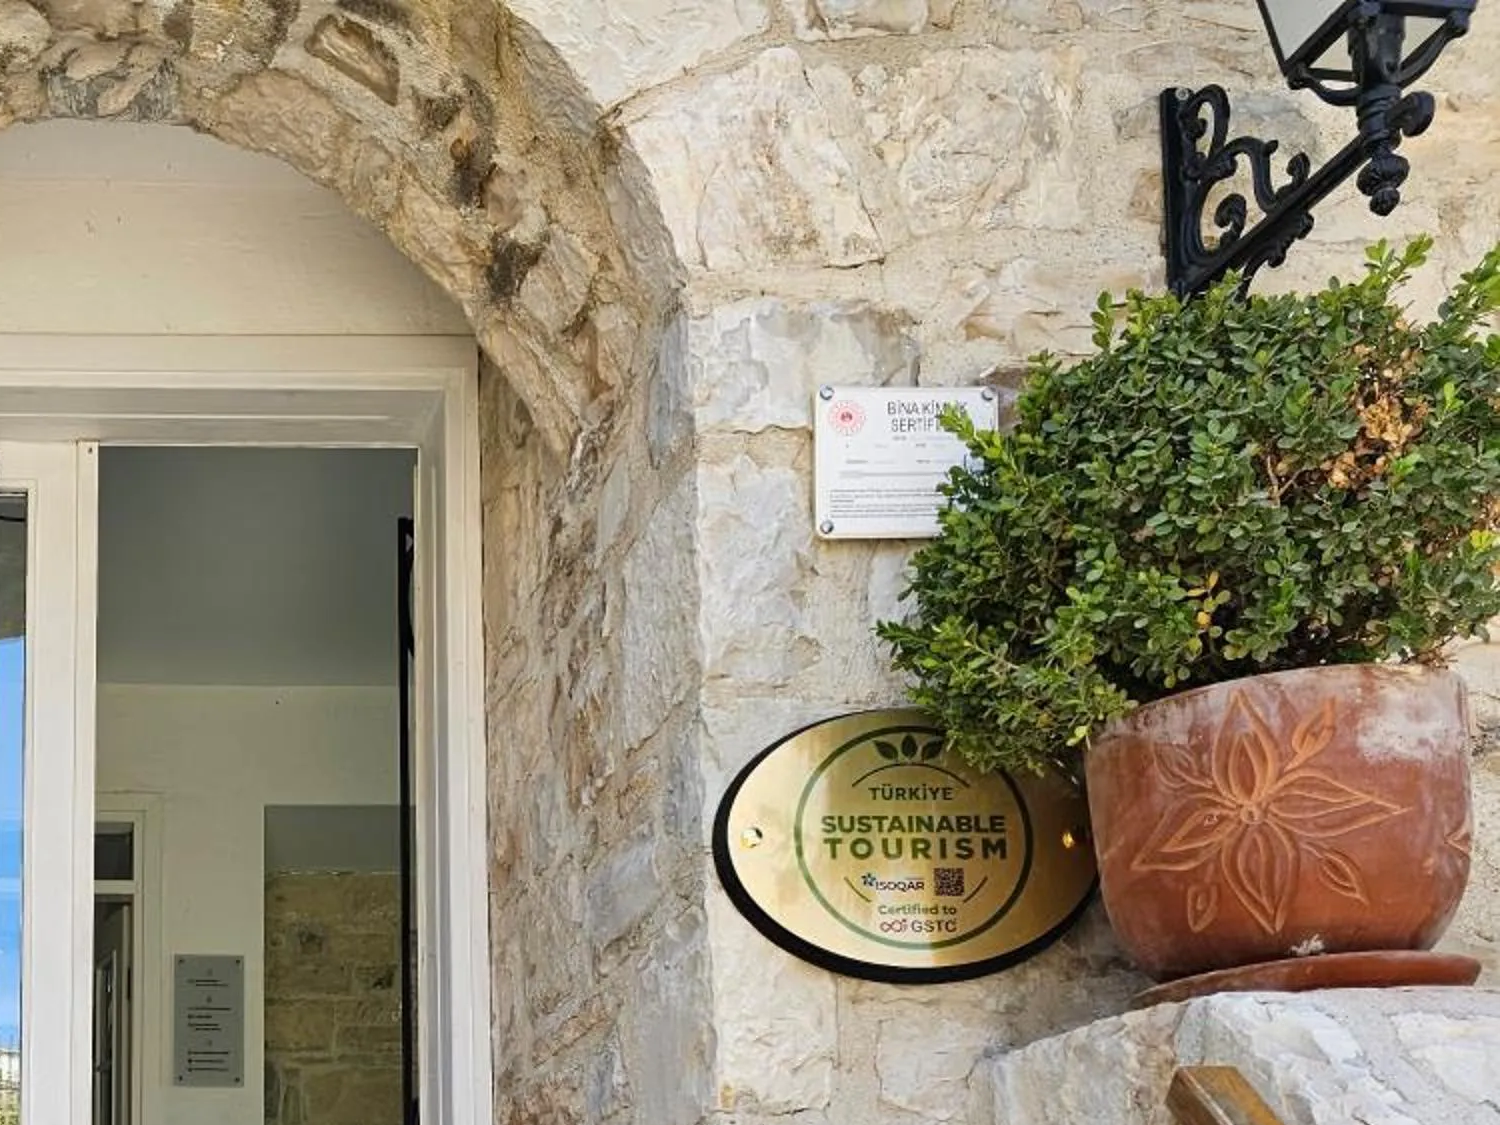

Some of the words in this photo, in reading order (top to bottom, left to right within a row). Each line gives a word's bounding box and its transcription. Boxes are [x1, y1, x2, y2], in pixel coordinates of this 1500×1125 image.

[869, 783, 953, 801] TÜRKİYE
[821, 815, 1006, 834] SUSTAINABLE
[823, 837, 1007, 860] TOURISM
[875, 881, 925, 892] ISOQAR
[878, 904, 939, 915] Certified
[942, 905, 957, 915] to
[911, 918, 957, 933] GSTC
